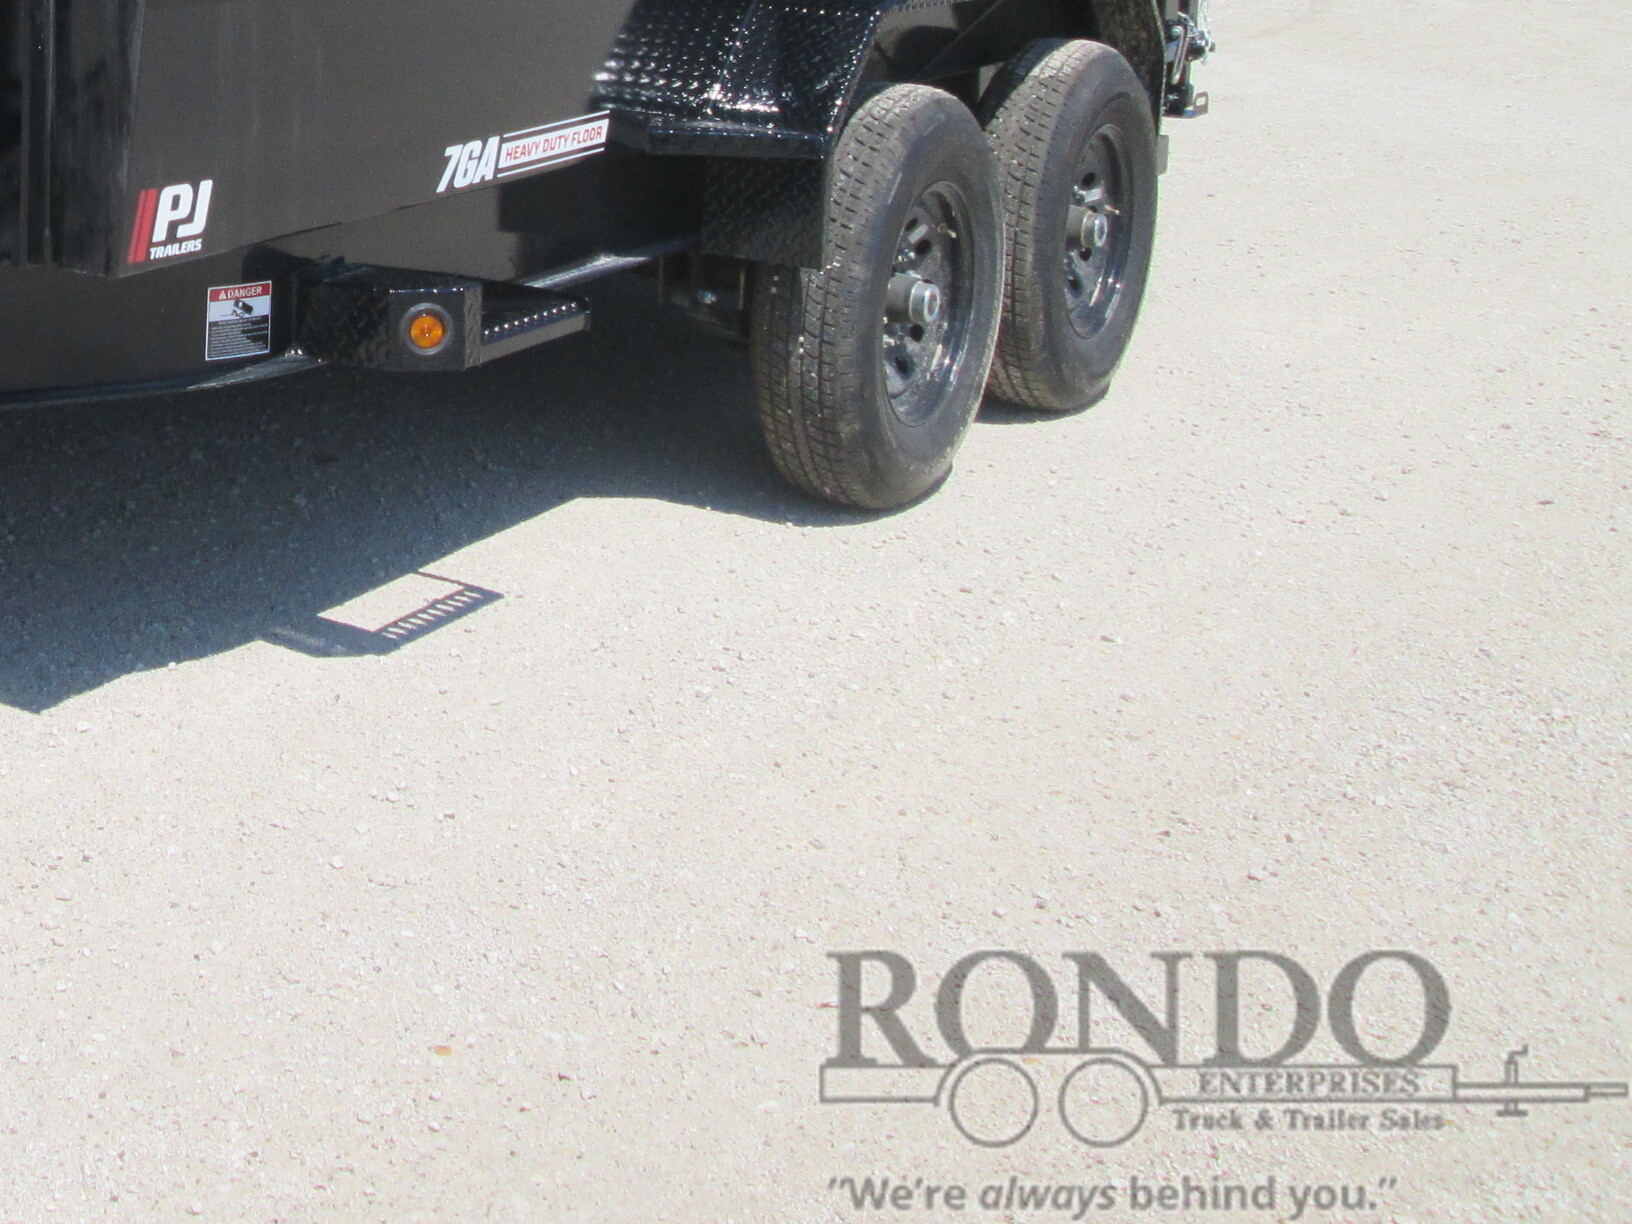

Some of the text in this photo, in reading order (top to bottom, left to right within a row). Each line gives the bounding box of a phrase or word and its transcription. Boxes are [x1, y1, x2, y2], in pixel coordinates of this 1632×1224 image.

[436, 125, 603, 193] 7GA HEAVY DUTY FLOOR
[152, 179, 213, 243] PJ
[150, 238, 203, 260] TRAILERS
[228, 286, 262, 299] DANGER
